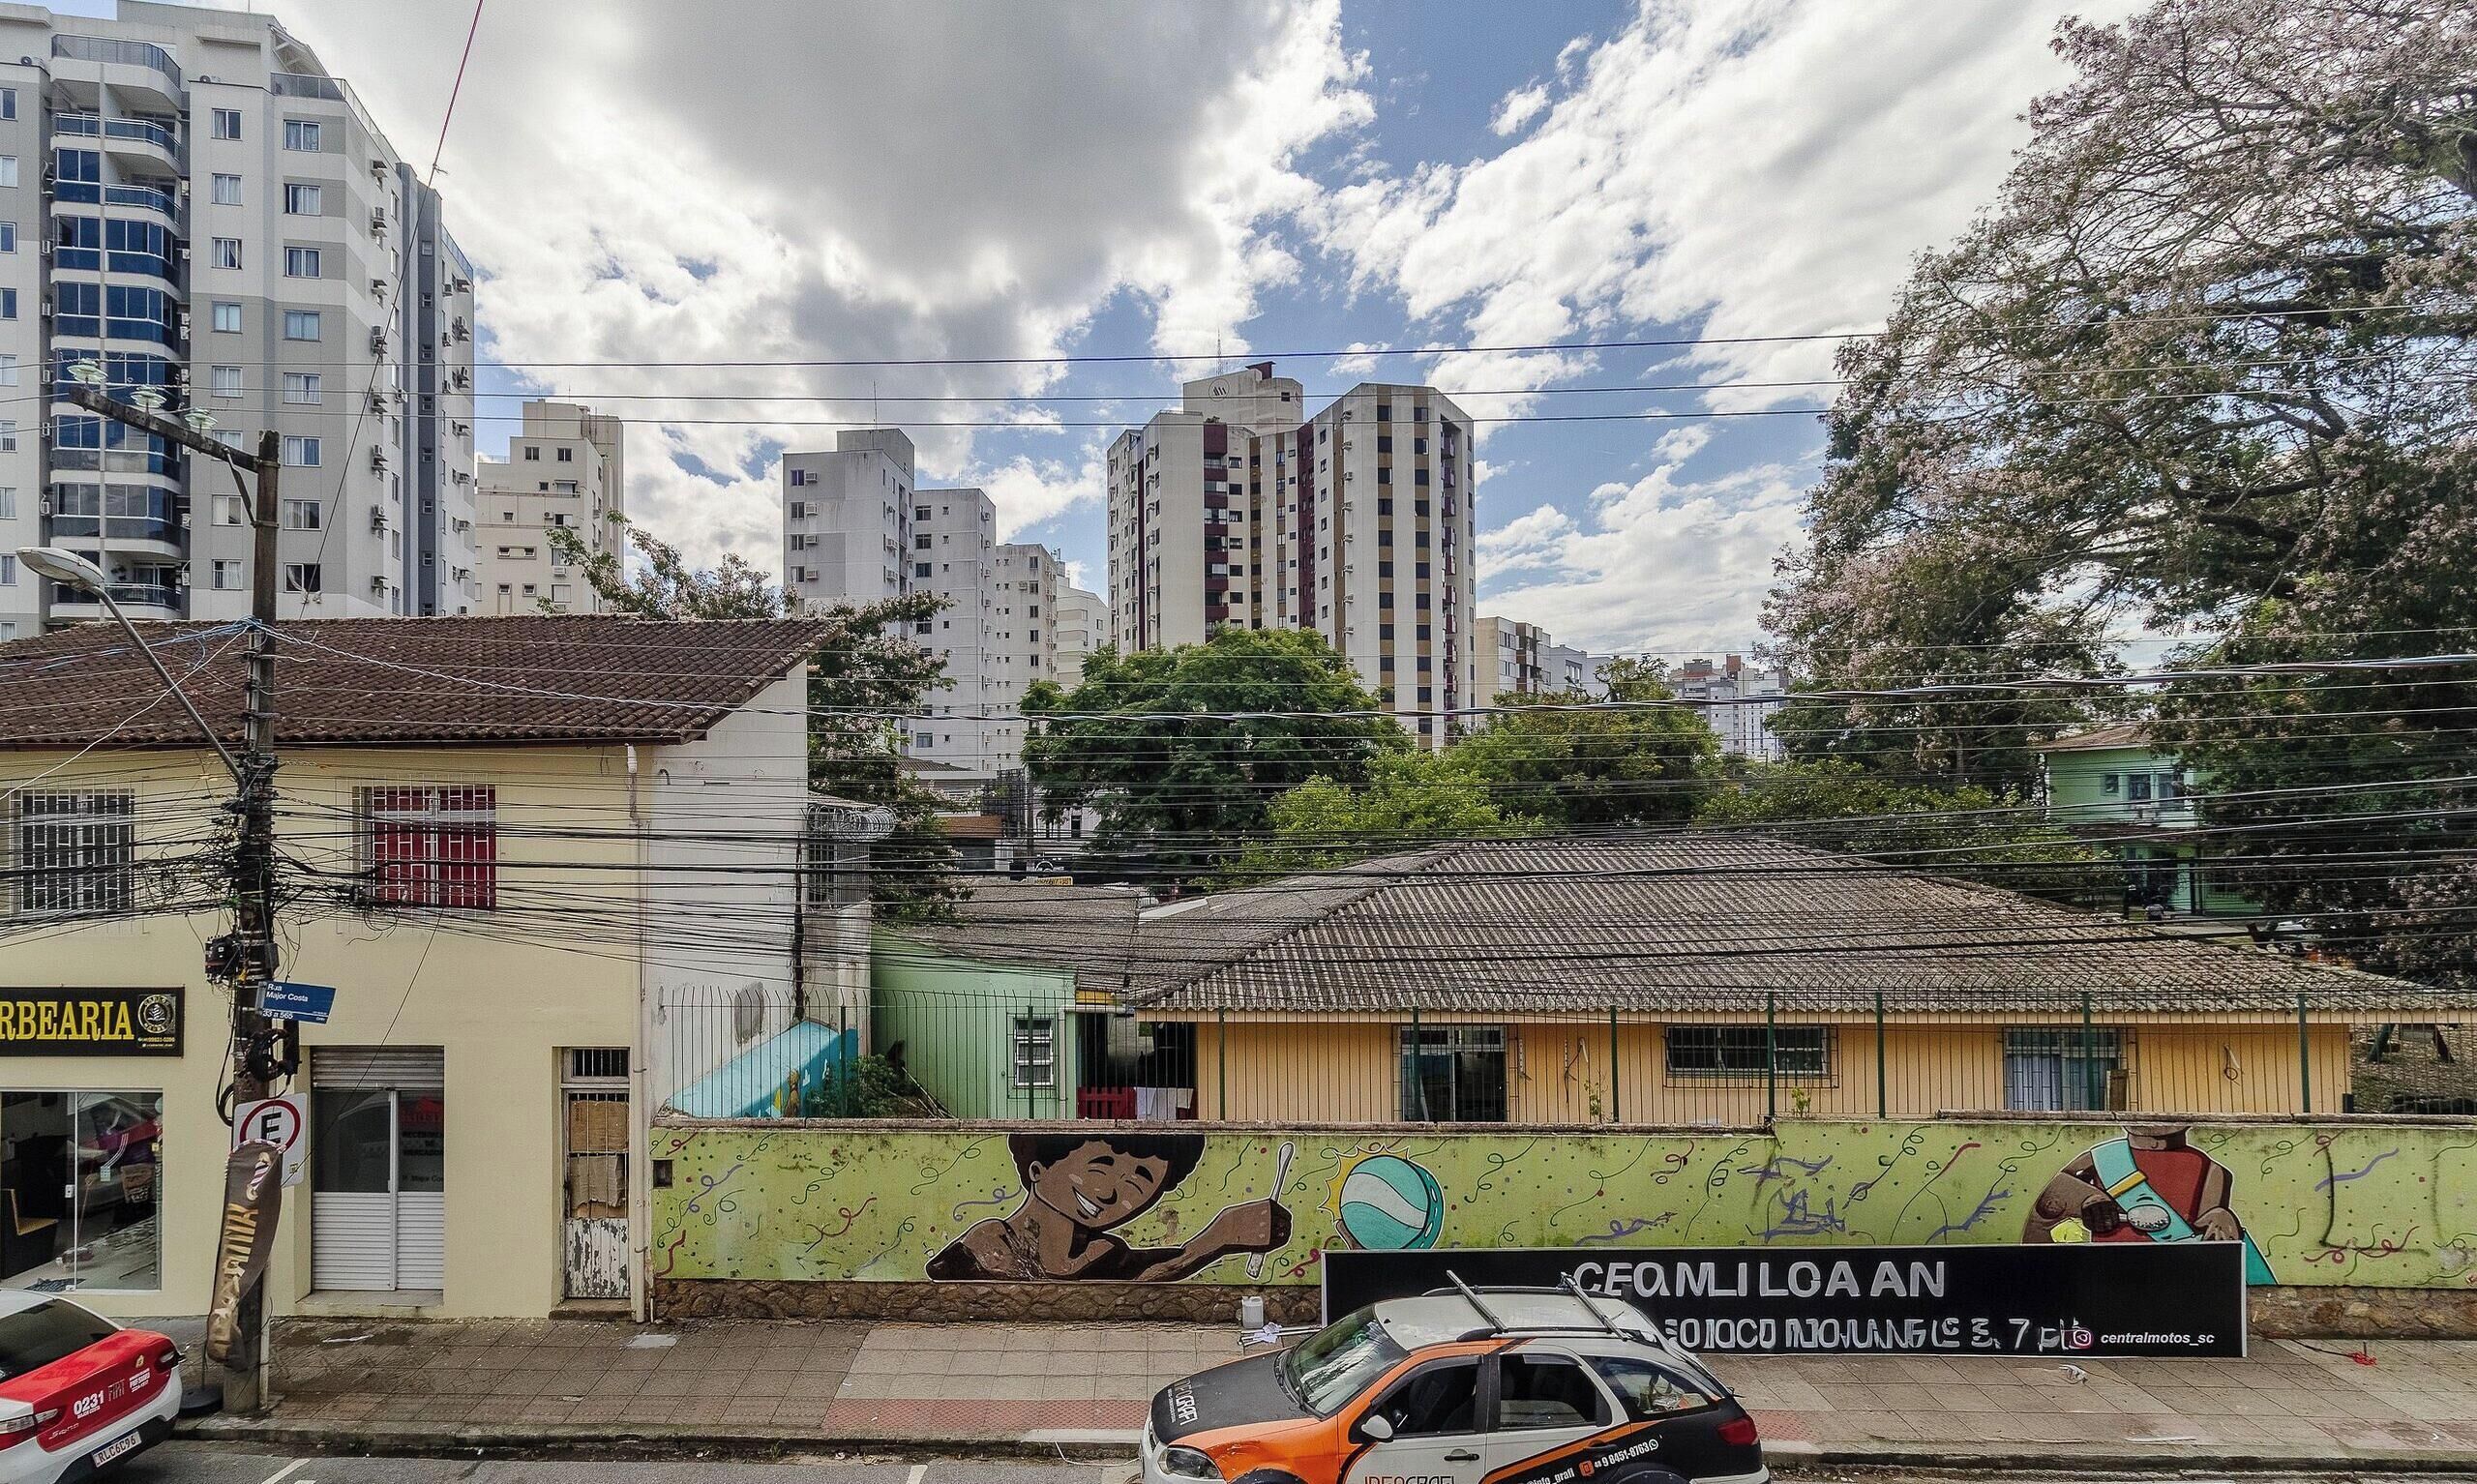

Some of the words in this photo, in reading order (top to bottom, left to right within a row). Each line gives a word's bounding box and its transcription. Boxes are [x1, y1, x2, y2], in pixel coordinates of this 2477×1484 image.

[266, 992, 286, 1000] Major
[287, 994, 309, 1002] Costa
[268, 983, 283, 992] Rua
[0, 1001, 134, 1041] RBEARIA
[260, 1112, 282, 1143] E
[2101, 1332, 2215, 1347] centralmotos_sc
[74, 1390, 104, 1415] 0231
[1601, 1456, 1609, 1468] 9
[1608, 1441, 1650, 1465] 8451-8763
